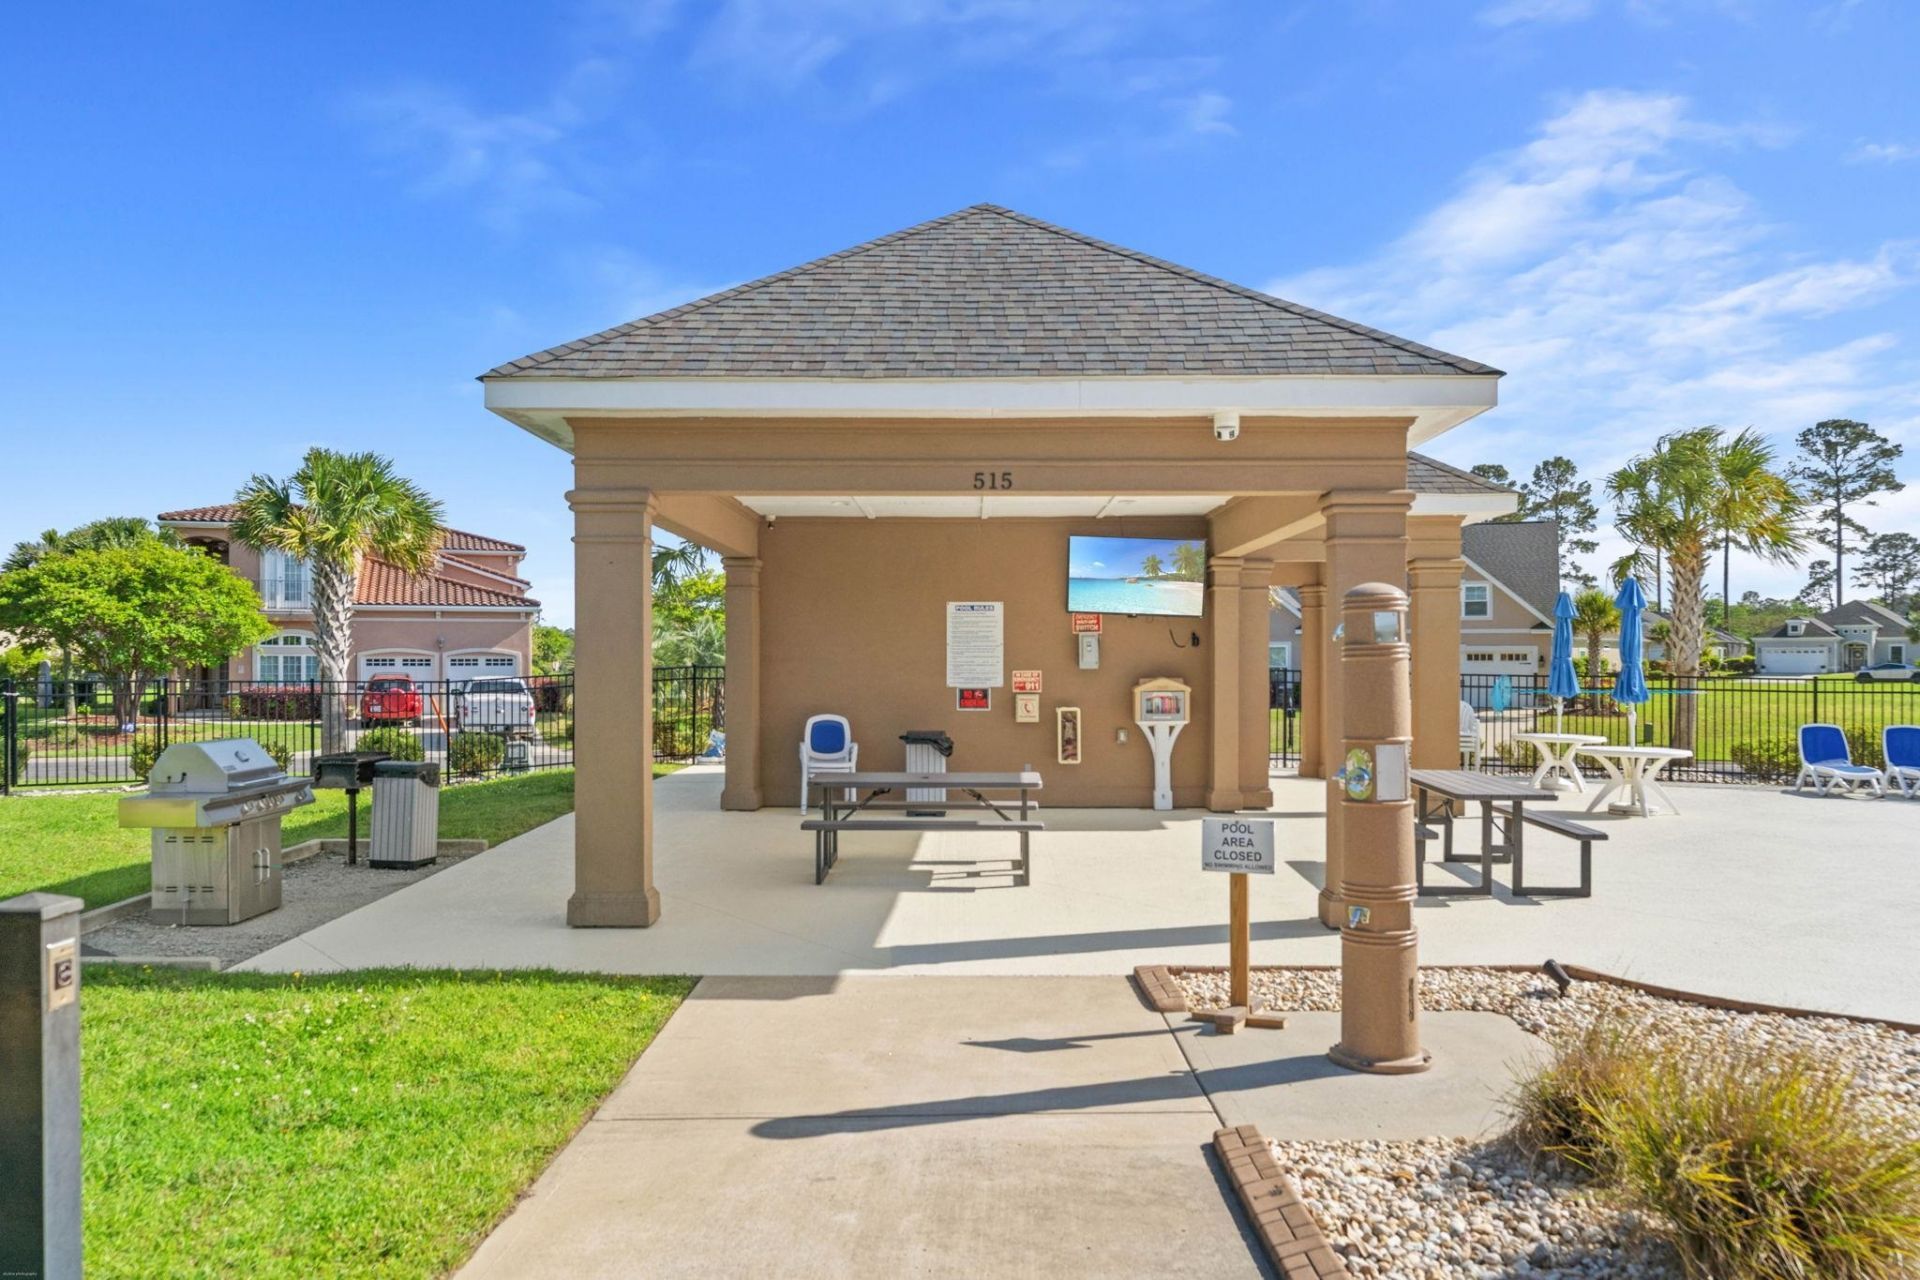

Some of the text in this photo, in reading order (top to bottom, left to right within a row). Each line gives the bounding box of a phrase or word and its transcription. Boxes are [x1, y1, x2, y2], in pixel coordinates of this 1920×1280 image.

[973, 472, 1012, 490] 515
[1025, 682, 1039, 690] 911
[1221, 823, 1254, 834] POOL
[1221, 837, 1254, 848] AREA
[1214, 850, 1262, 862] CLOSED
